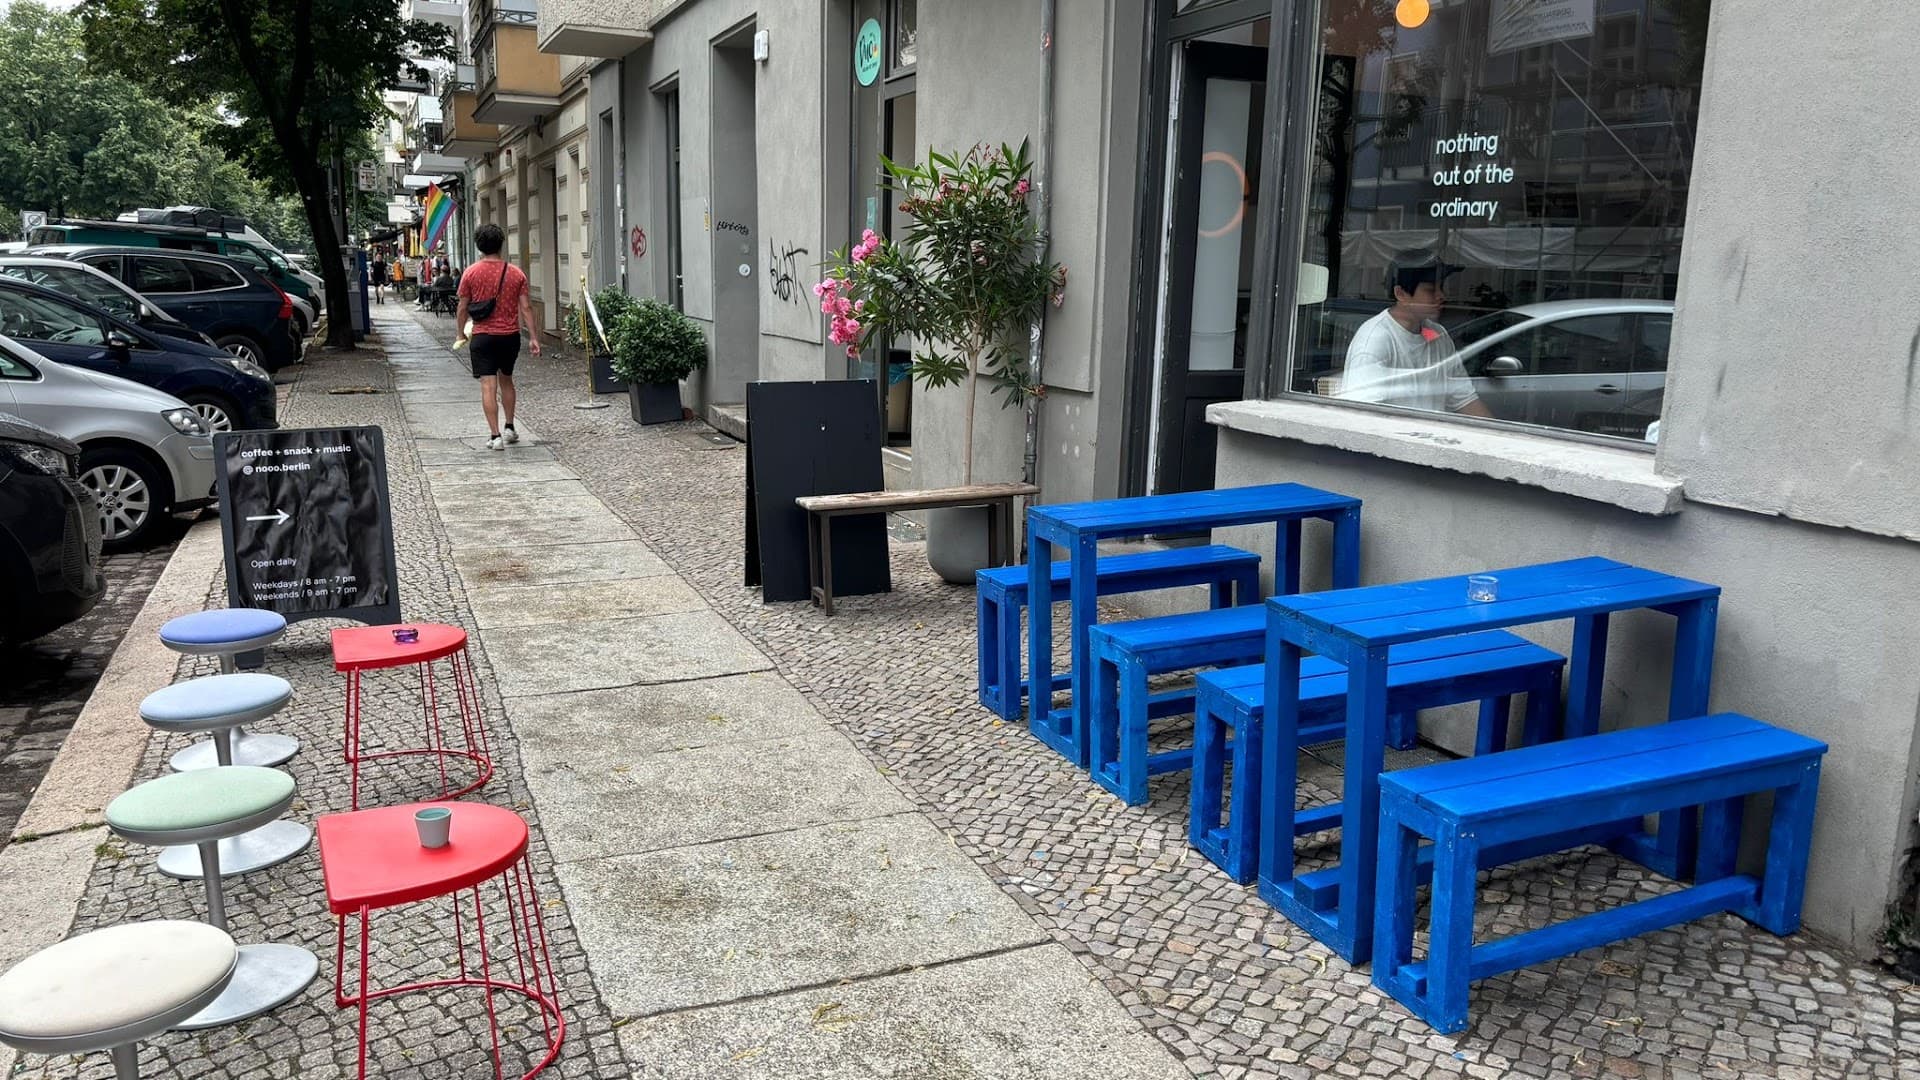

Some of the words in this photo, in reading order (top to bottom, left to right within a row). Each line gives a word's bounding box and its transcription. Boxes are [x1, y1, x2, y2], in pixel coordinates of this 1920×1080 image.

[1436, 132, 1499, 156] nothing
[1433, 165, 1461, 186] out
[1463, 164, 1482, 185] of
[1485, 163, 1514, 184] the
[1430, 197, 1499, 221] ordinary
[241, 448, 273, 458] coffee
[283, 446, 313, 456] snack
[323, 444, 352, 454] music
[255, 462, 311, 473] nooo.berlin
[250, 559, 275, 570] Open
[276, 557, 297, 567] daily
[252, 580, 298, 590] Weekdays
[305, 577, 312, 586] 8
[313, 577, 327, 585] am
[335, 575, 341, 583] 7
[342, 575, 356, 584] pm
[253, 590, 299, 601] Weekends
[307, 588, 313, 597] 9
[315, 588, 328, 596] am
[336, 586, 342, 594] 7
[344, 586, 358, 595] pm
